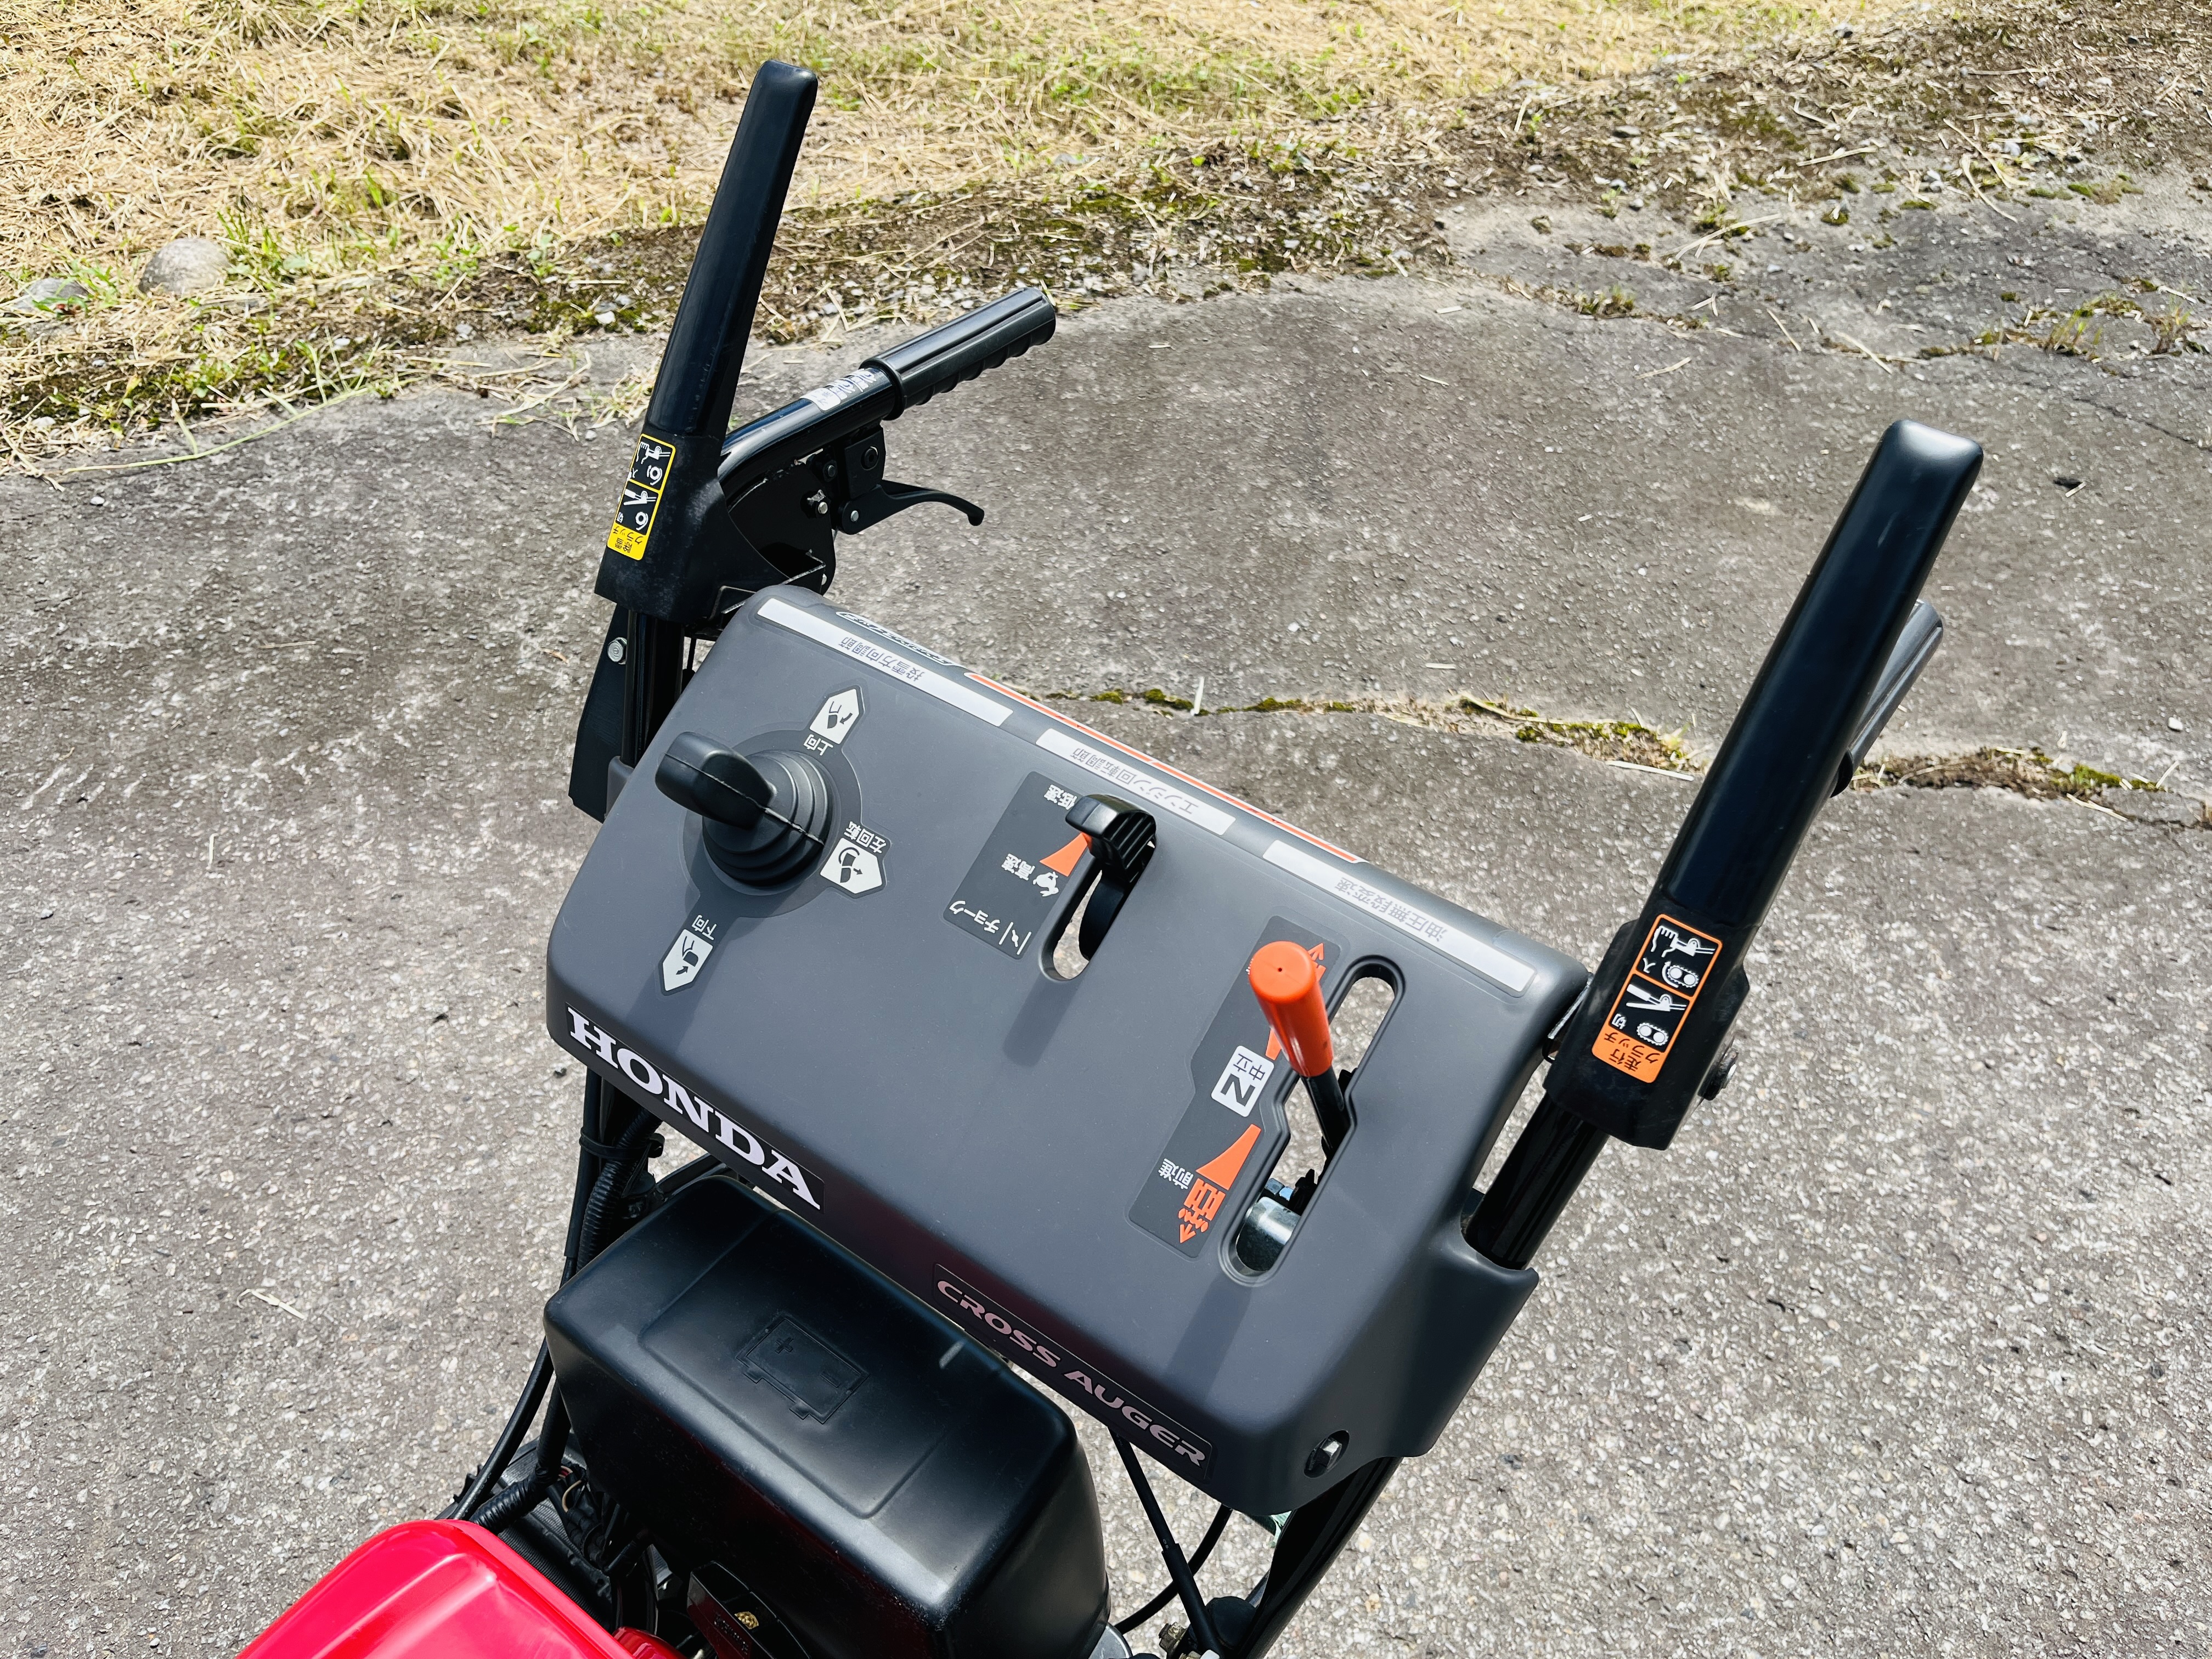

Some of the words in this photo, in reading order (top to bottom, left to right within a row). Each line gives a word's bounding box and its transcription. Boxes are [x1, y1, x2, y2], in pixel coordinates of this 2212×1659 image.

[613, 526, 644, 544] クラッチ
[838, 637, 926, 681] 投雪方向調節
[804, 734, 834, 755] 上向
[1043, 784, 1077, 810] 低速
[1070, 748, 1199, 814] エンジン回転調節
[844, 821, 887, 854] 左回転
[1001, 853, 1036, 881] 高速
[949, 900, 1001, 934] チョーク
[1334, 877, 1448, 943] 油圧無段変速
[691, 915, 717, 940] 下向
[1643, 957, 1656, 973] 入
[1611, 1013, 1627, 1030] 切
[1604, 1032, 1661, 1064] クラッチ
[1609, 1048, 1641, 1072] 走行
[1233, 1053, 1266, 1081] 中立
[1220, 1074, 1256, 1107] N
[567, 1007, 821, 1210] HONDA
[1158, 1158, 1194, 1190] 前進
[937, 1280, 1060, 1367] CROSS
[1064, 1370, 1205, 1467] AUGER
